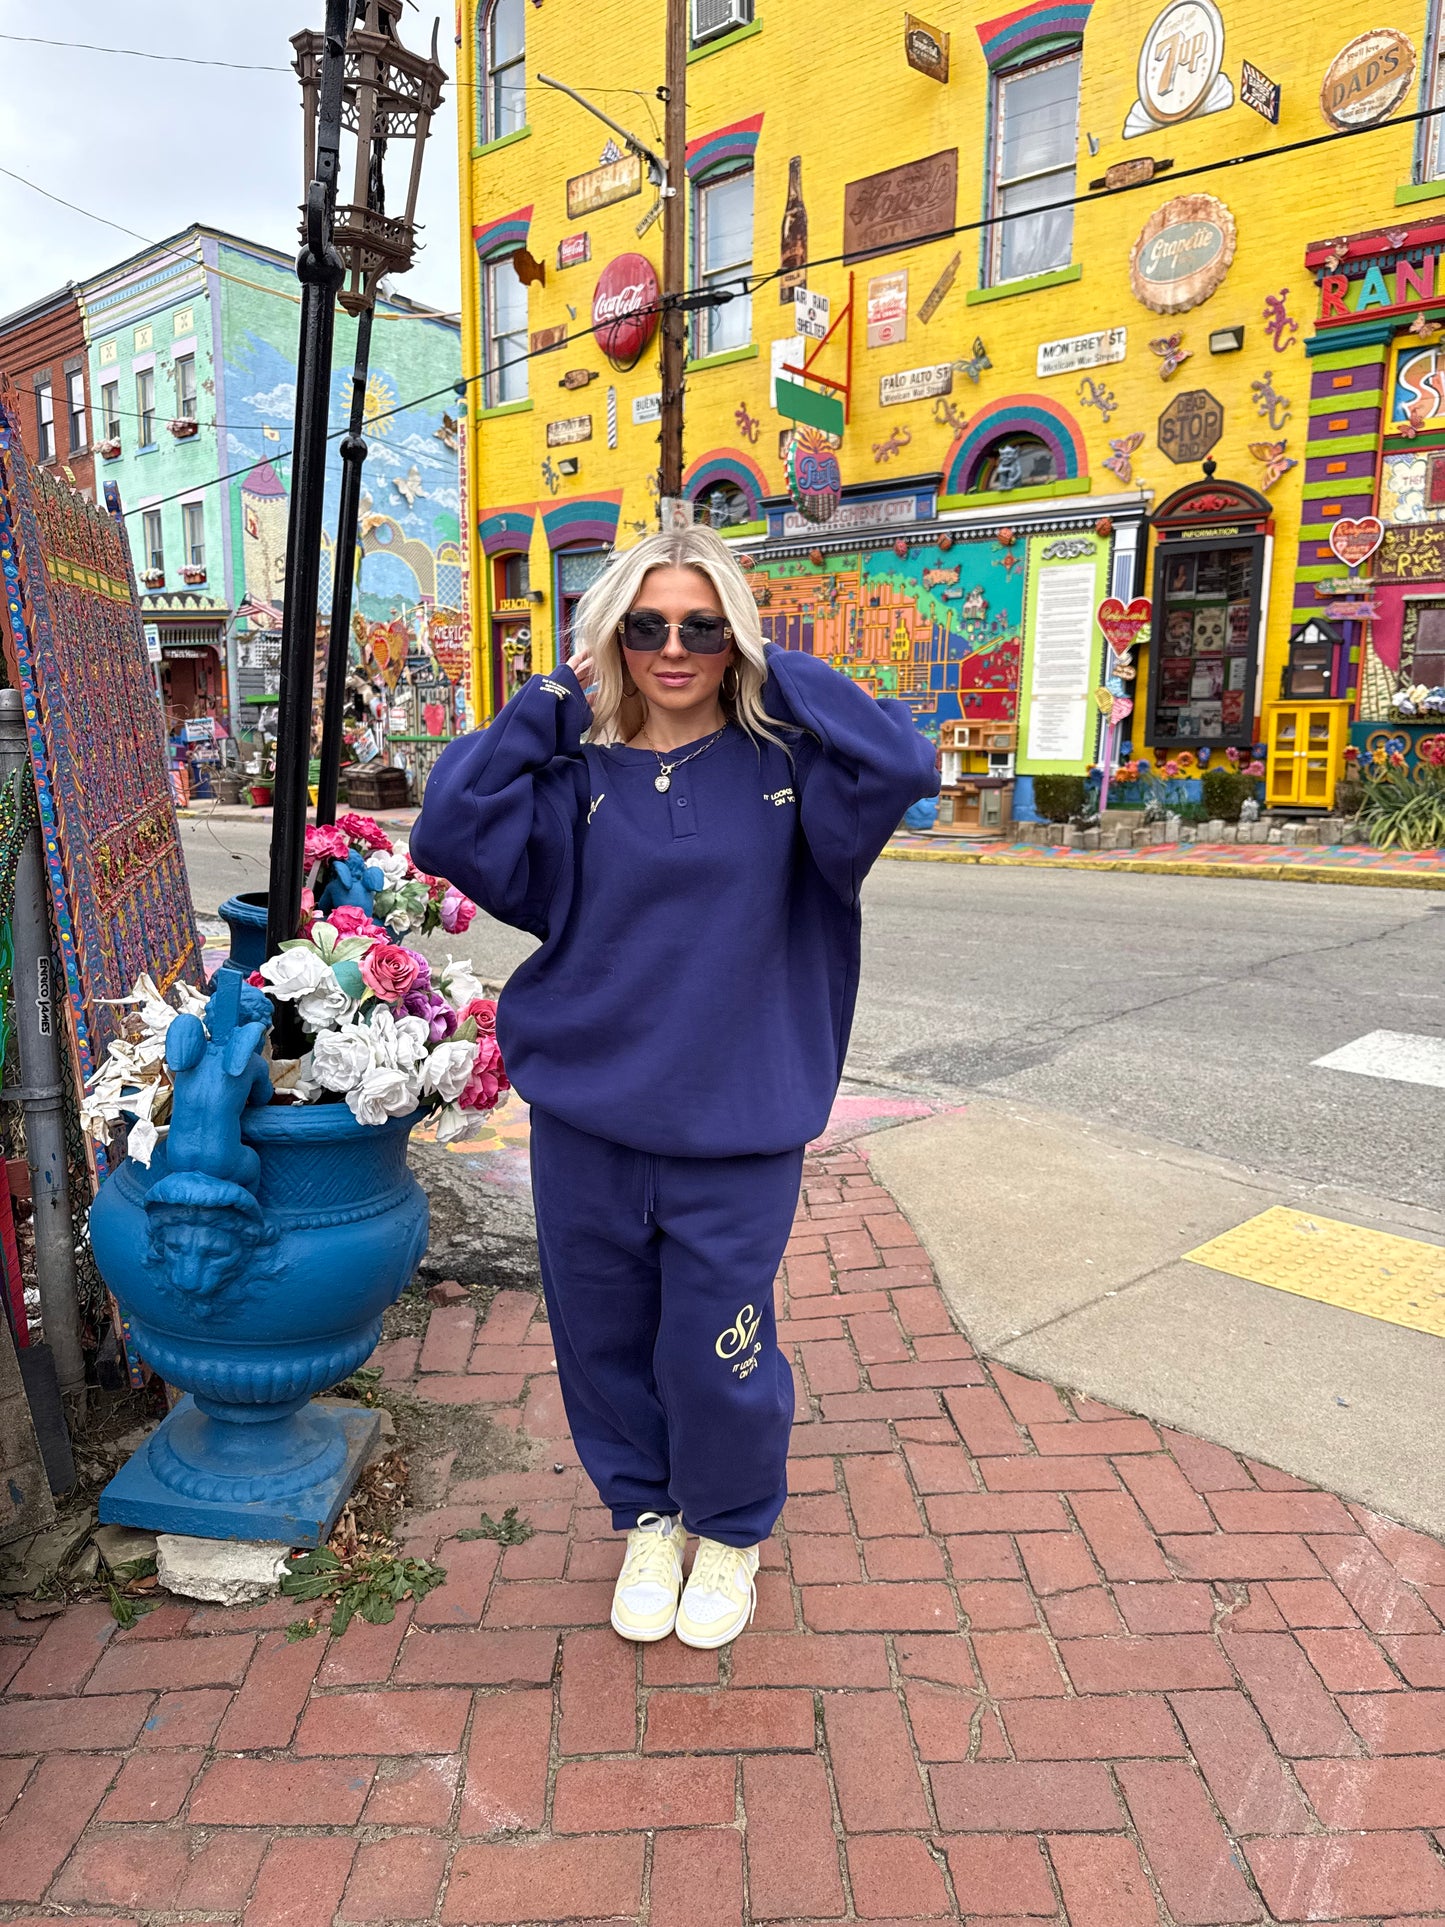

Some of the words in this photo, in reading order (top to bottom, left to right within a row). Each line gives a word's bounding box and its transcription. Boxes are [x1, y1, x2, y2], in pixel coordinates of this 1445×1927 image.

[1332, 46, 1399, 108] DAD'S
[1321, 252, 1445, 319] RAN
[797, 318, 827, 340] SHELTER
[1109, 331, 1124, 346] ST
[910, 370, 932, 385] ALTO
[1162, 411, 1218, 443] STOP
[1178, 442, 1200, 458] END
[884, 499, 914, 517] CITY
[1181, 527, 1239, 539] INFORMATION
[462, 570, 472, 643] WELCOME
[463, 650, 472, 701] HOUSE
[771, 788, 793, 800] LOOKS
[775, 797, 786, 806] ON
[40, 958, 49, 997] ENRICO
[37, 1000, 50, 1035] JAMES
